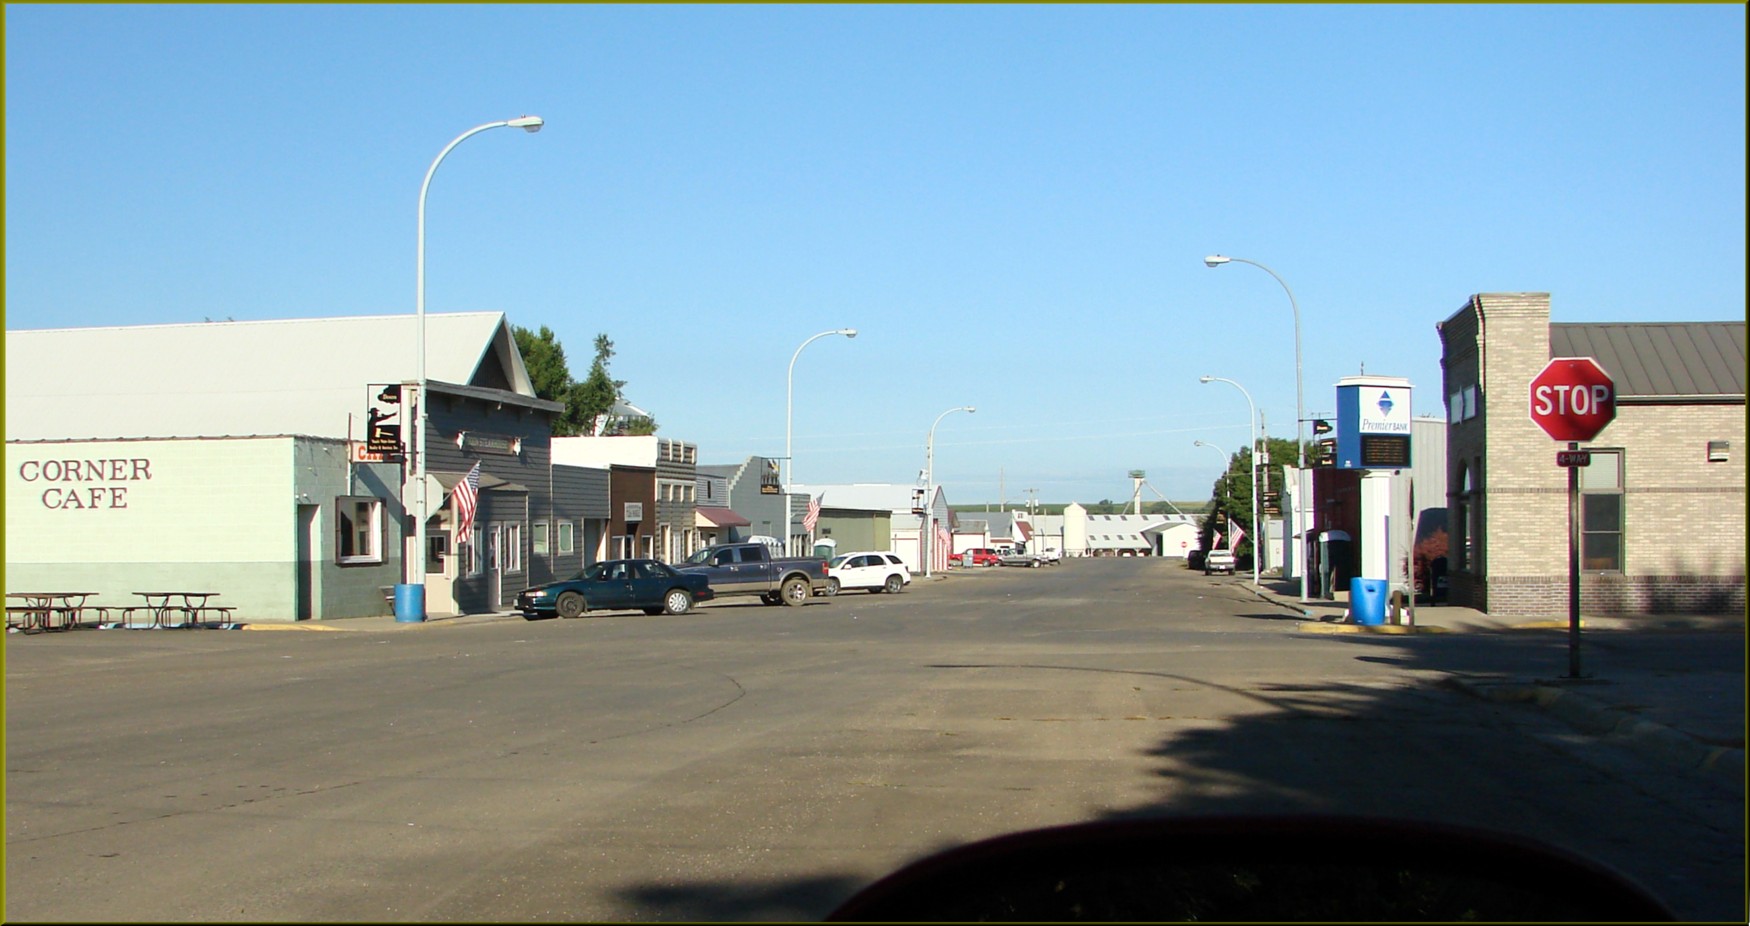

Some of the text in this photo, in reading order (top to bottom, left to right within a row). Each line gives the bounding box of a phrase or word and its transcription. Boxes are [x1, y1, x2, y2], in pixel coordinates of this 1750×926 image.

[1535, 385, 1609, 416] STOP
[1361, 418, 1408, 431] Premier BANK
[19, 458, 152, 482] CORNER
[1559, 454, 1588, 464] 4-WAY
[42, 487, 128, 509] CAFE
